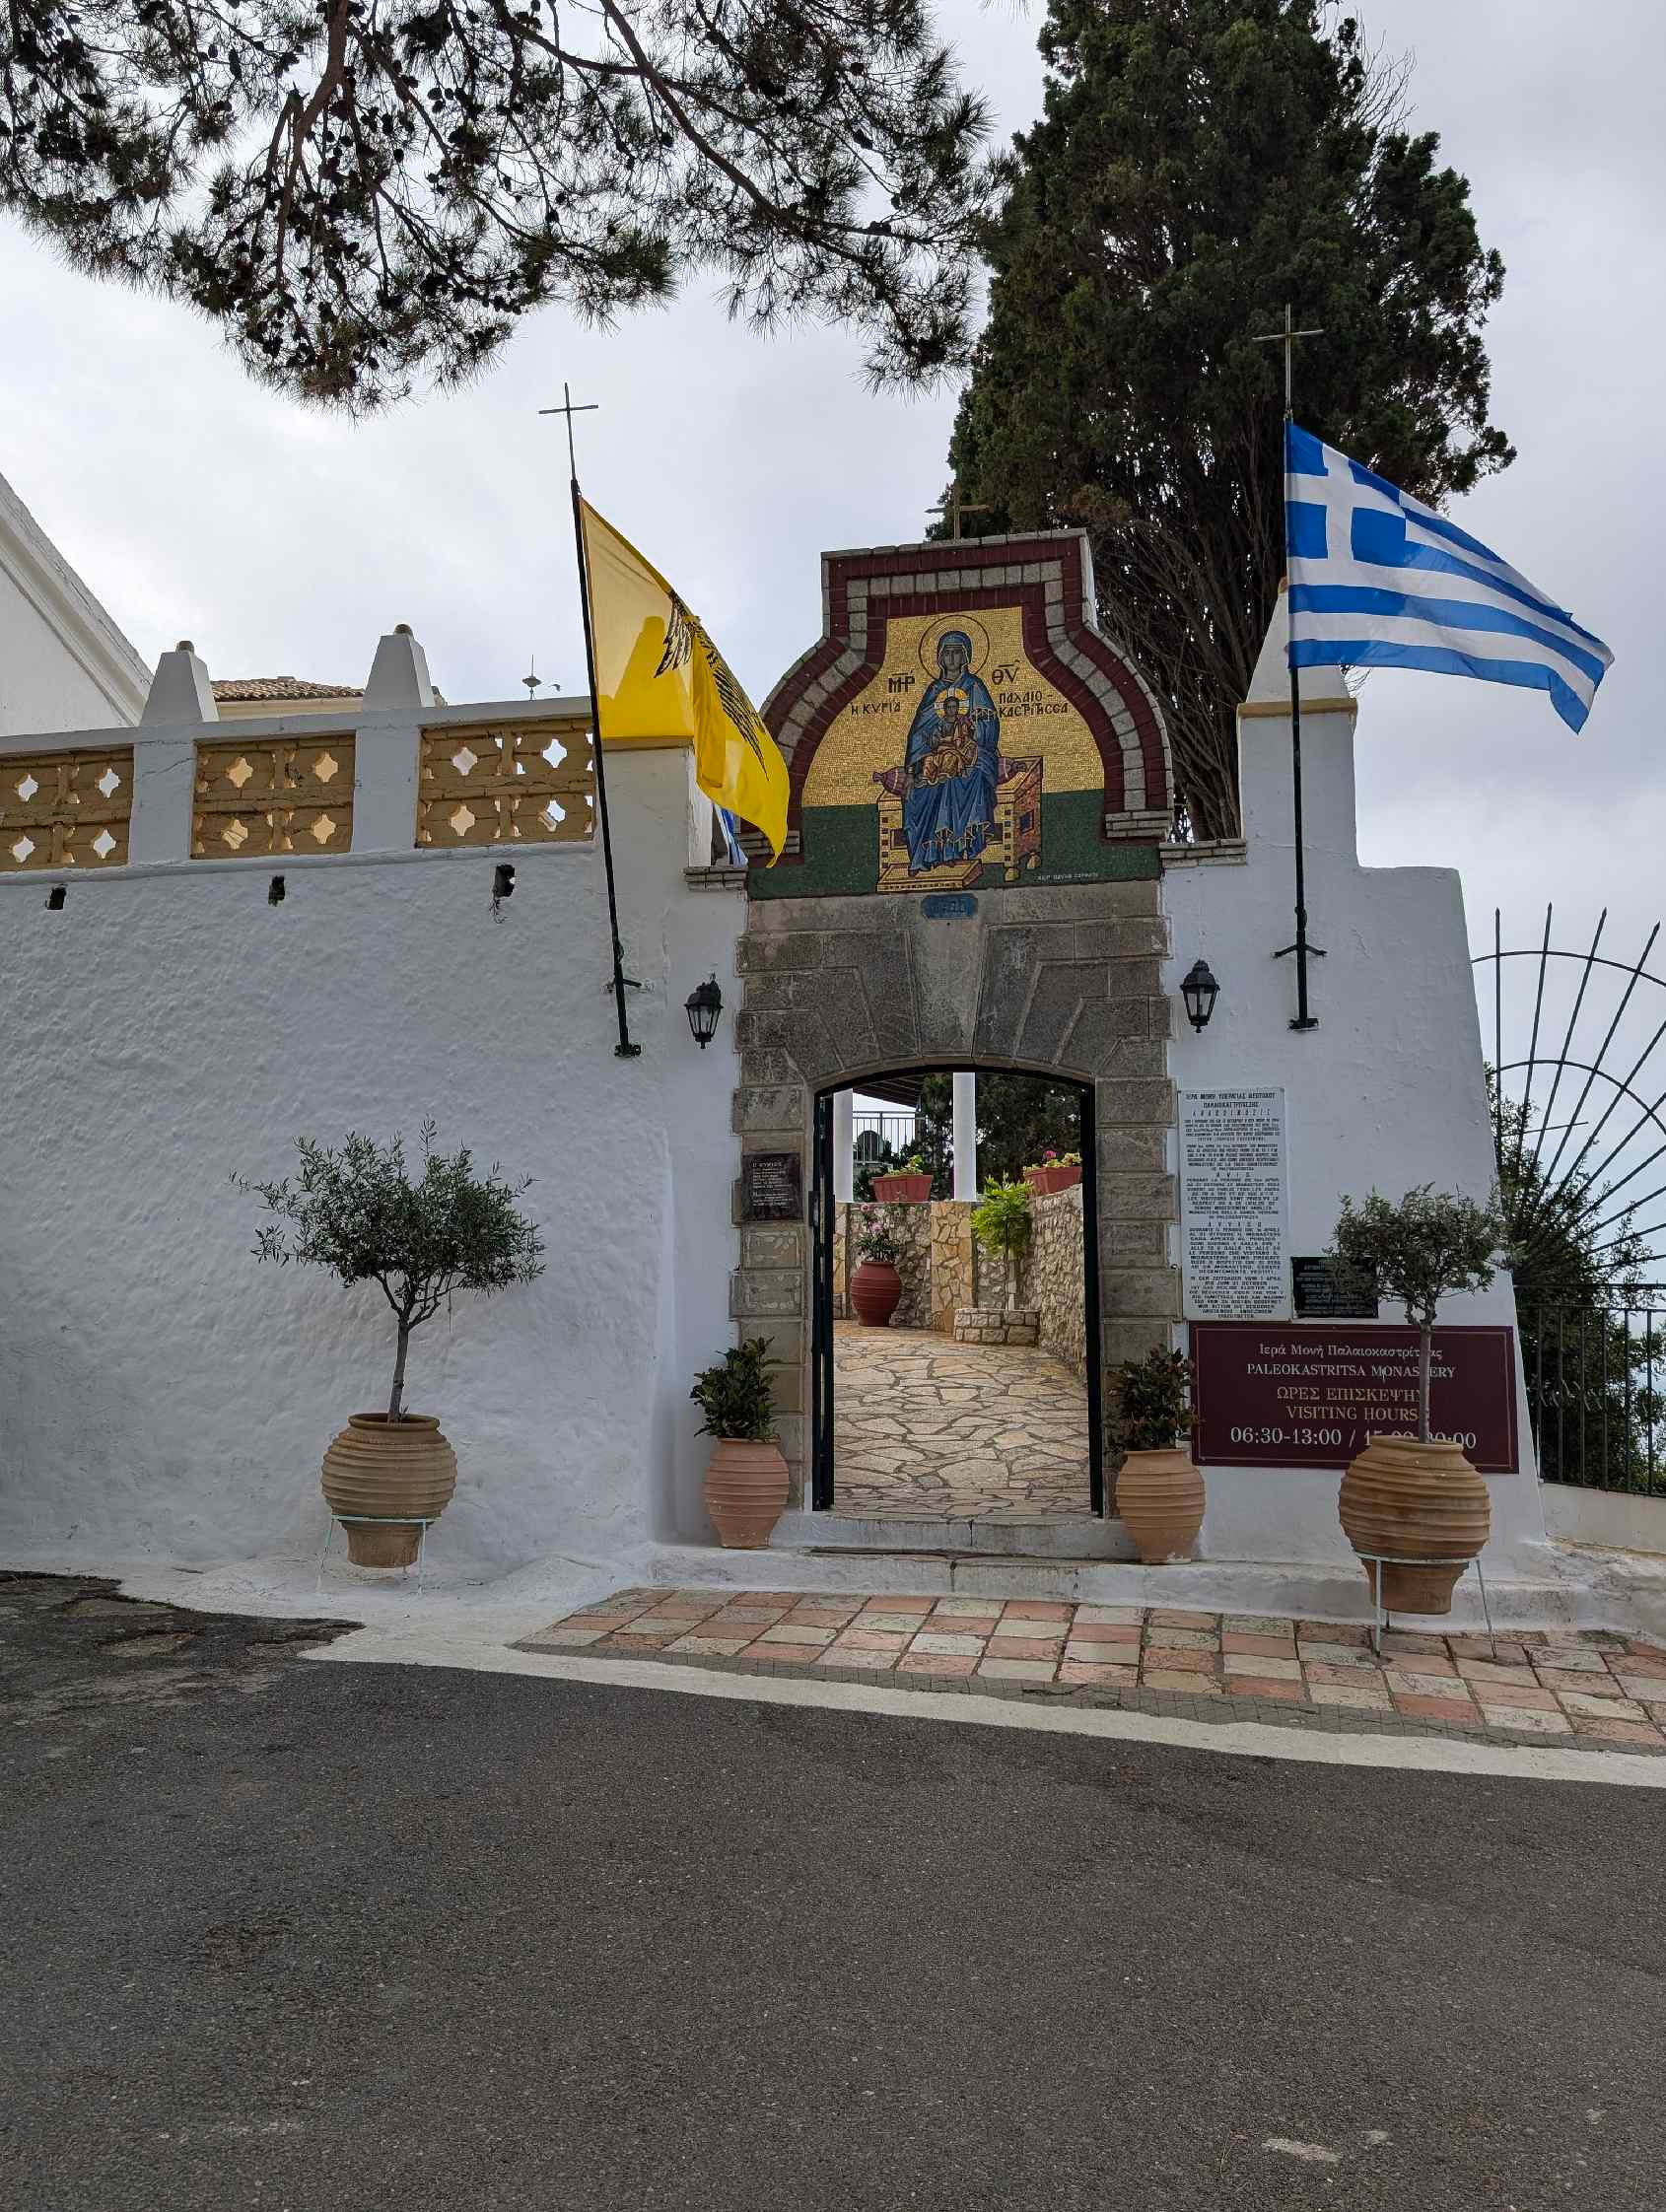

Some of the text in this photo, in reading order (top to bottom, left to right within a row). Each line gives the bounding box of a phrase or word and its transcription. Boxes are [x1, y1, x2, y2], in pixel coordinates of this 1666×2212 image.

[1290, 1344, 1324, 1358] Μονή
[1246, 1363, 1455, 1378] PALEOKASTRITSA MONASERY
[1277, 1386, 1320, 1400] ΩΡΕΣ
[1285, 1406, 1357, 1419] VISITING
[1230, 1426, 1342, 1445] 06:30-13:00
